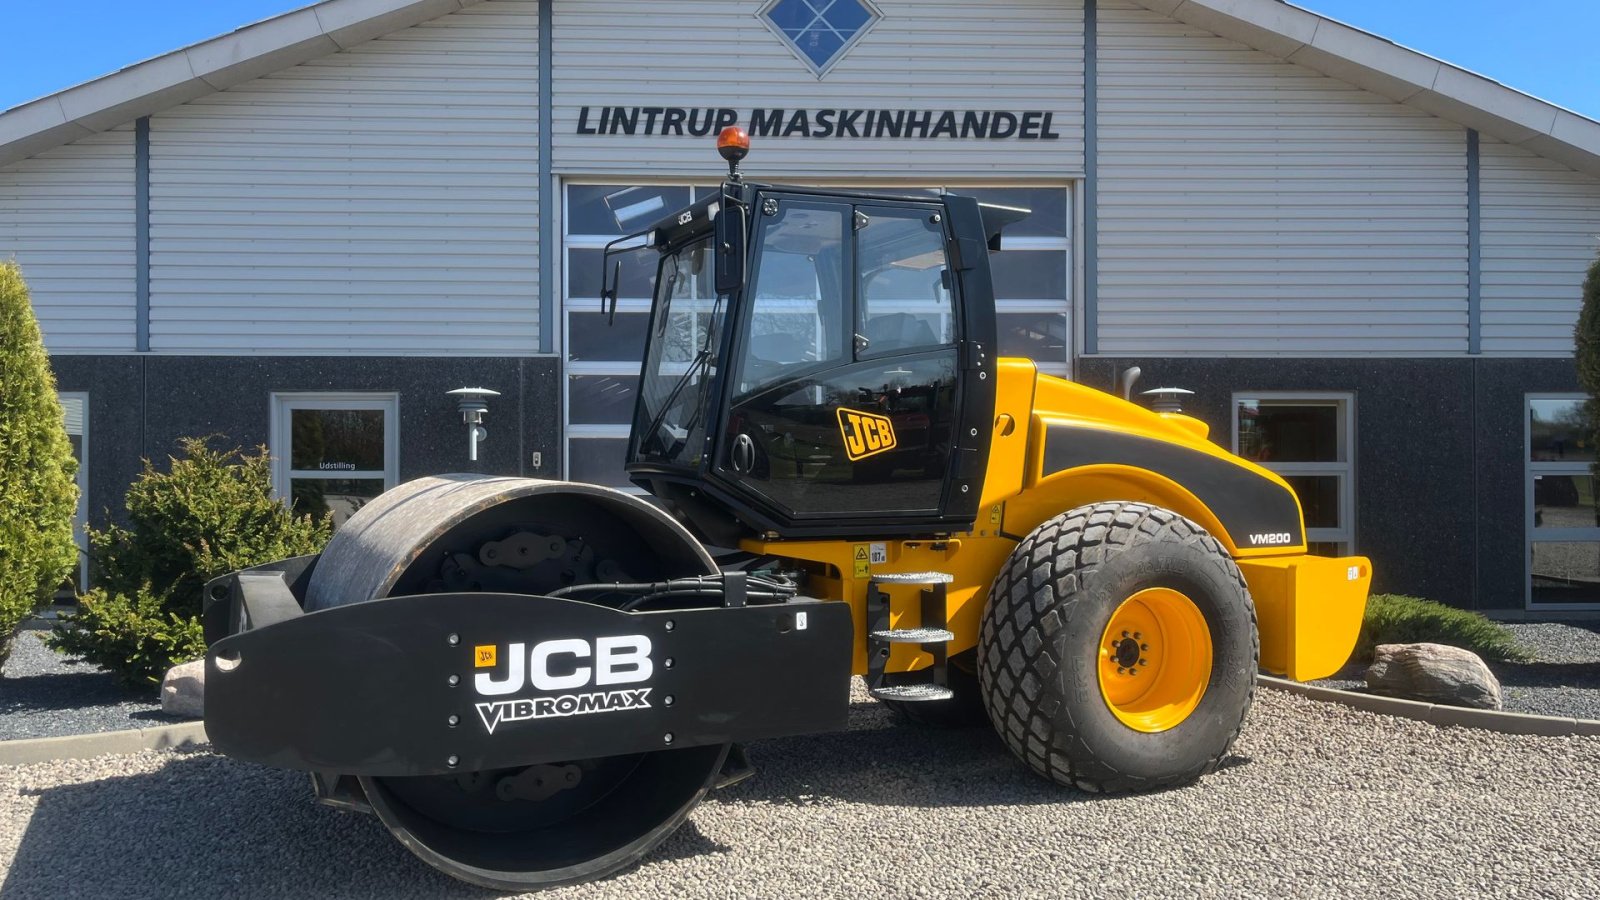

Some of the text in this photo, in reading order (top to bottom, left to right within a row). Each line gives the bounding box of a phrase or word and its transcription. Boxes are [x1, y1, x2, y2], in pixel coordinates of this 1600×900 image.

[577, 106, 1060, 139] LINTRUP MASKINHANDEL
[678, 211, 693, 226] JCB
[847, 413, 893, 455] JCB
[319, 461, 356, 471] Udstilling
[1249, 532, 1291, 544] VM200
[474, 634, 654, 696] JCB
[475, 688, 653, 735] VIBROMAX
